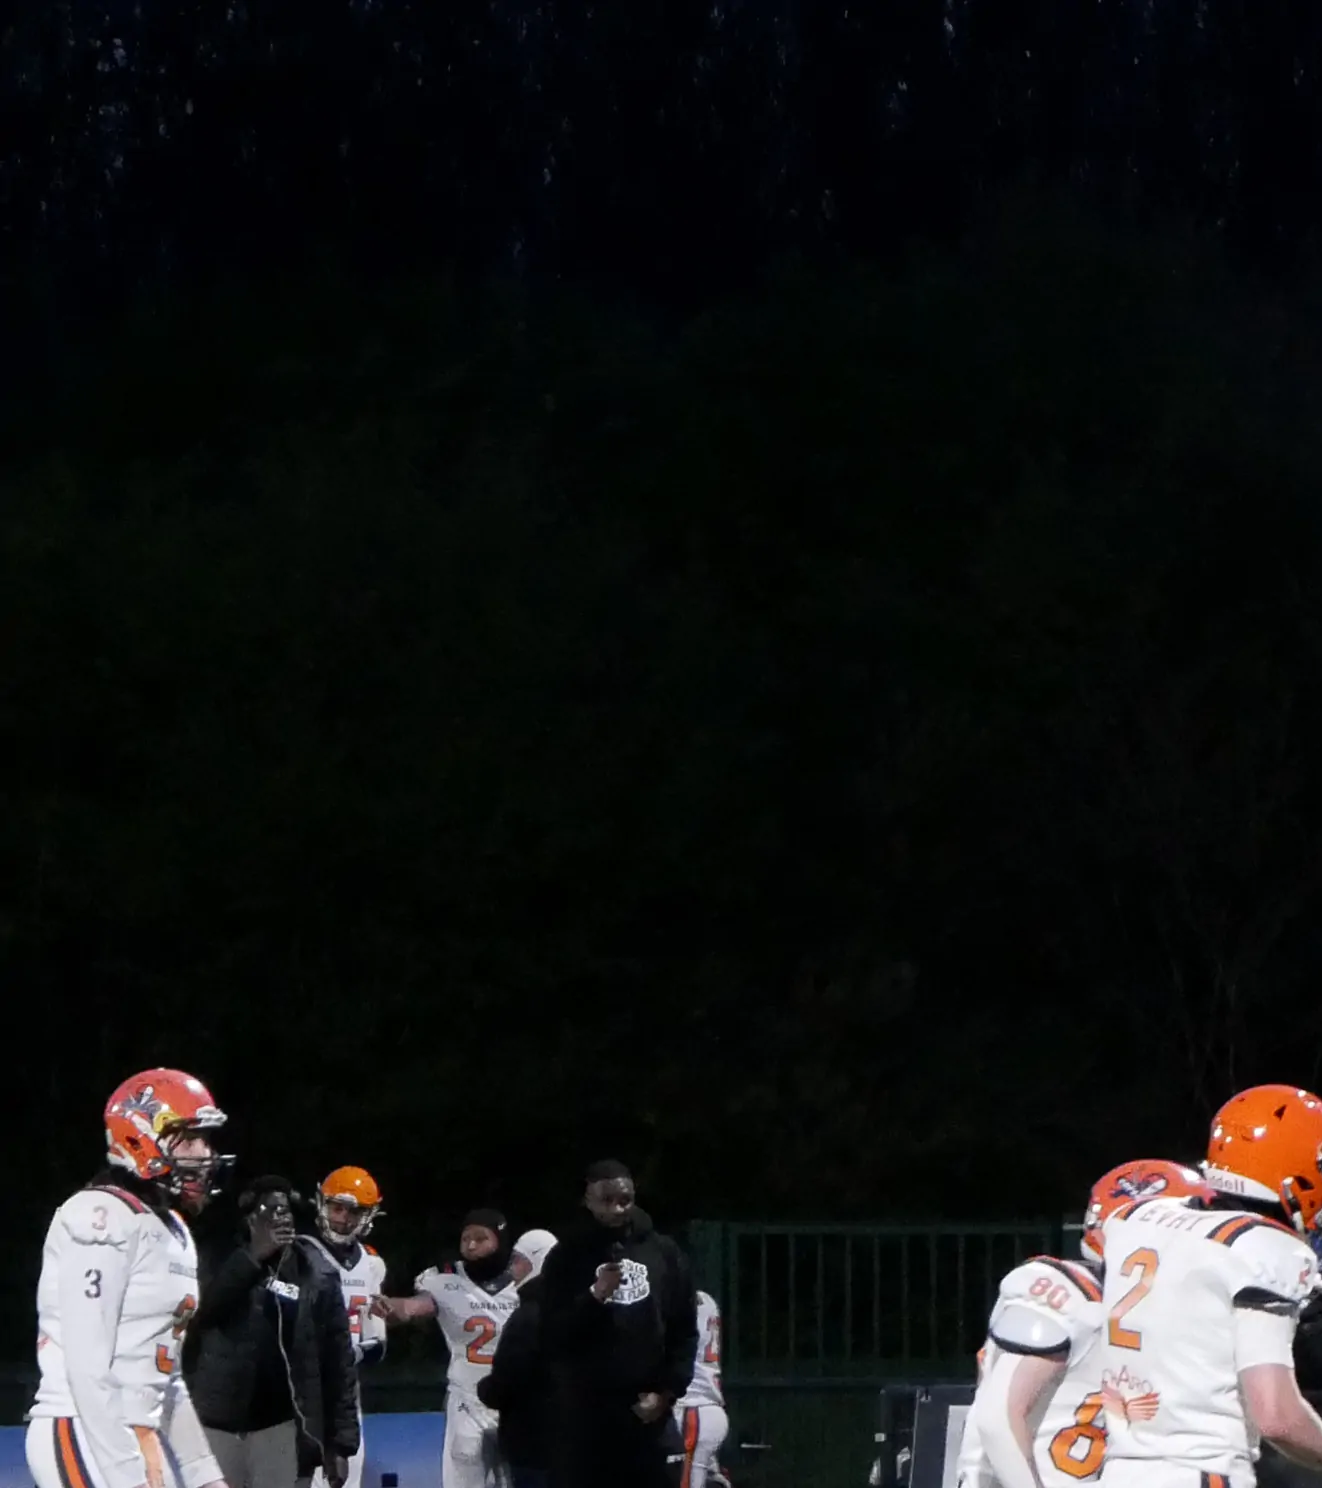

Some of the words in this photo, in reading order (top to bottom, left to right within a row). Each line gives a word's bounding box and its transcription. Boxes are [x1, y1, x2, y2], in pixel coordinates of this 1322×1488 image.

[91, 1205, 109, 1231] 3
[83, 1268, 102, 1299] 3
[1028, 1276, 1072, 1311] 80
[1108, 1246, 1161, 1352] 2
